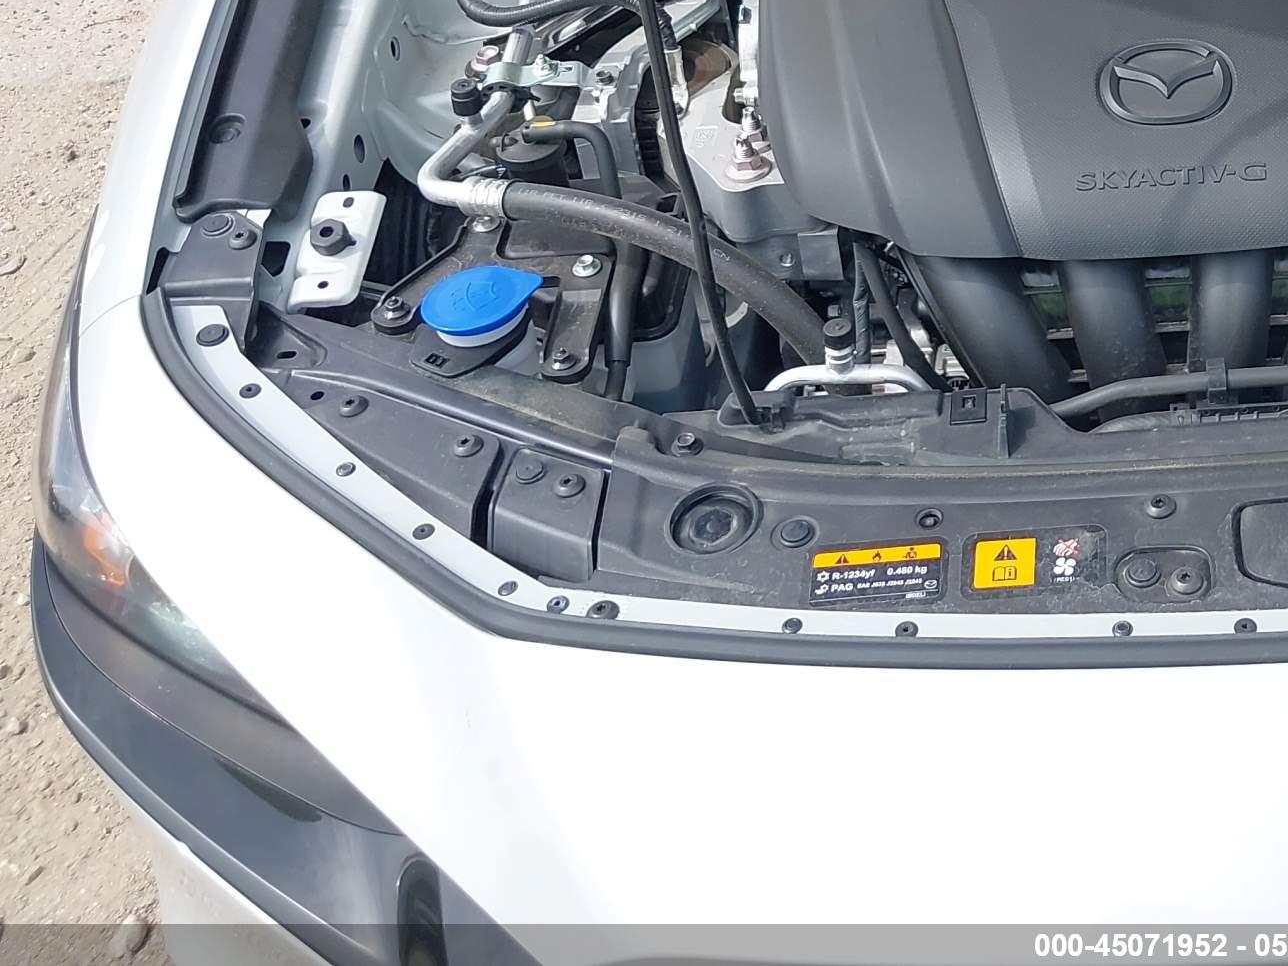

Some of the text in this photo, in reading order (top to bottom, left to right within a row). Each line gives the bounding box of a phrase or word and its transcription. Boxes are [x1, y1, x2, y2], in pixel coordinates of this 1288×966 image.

[1074, 162, 1268, 192] SKYACTIV-G
[832, 568, 875, 581] R-1234yf
[915, 565, 928, 575] kg
[831, 582, 853, 592] PAG
